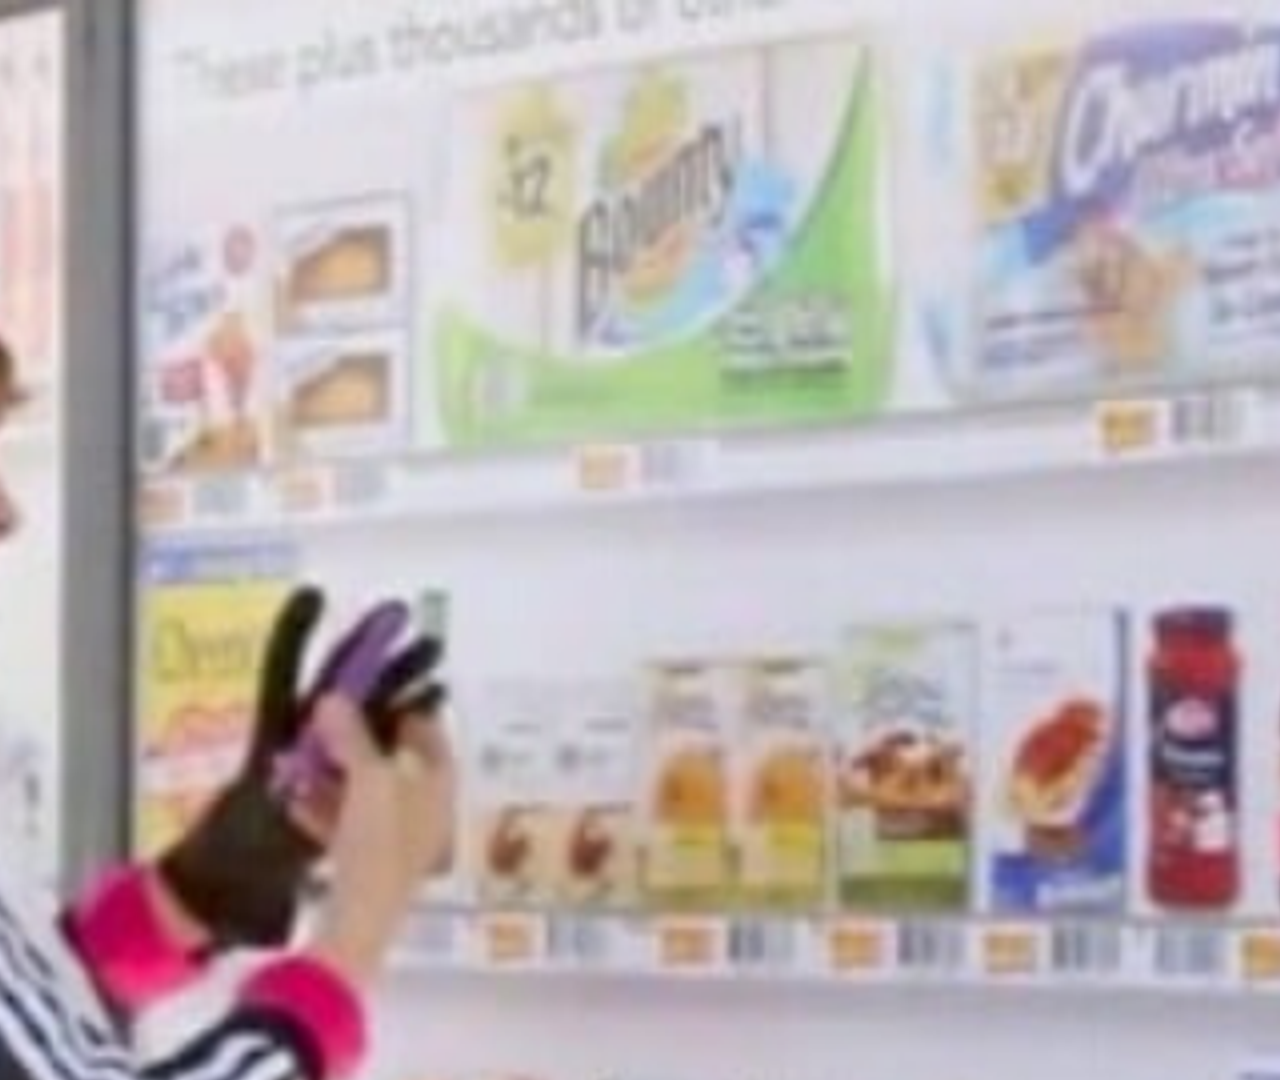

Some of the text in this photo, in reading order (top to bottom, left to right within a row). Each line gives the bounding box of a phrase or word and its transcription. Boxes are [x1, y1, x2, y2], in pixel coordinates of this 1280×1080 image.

[296, 26, 378, 92] plus
[389, 0, 602, 66] thousands
[576, 112, 738, 345] Bounty
